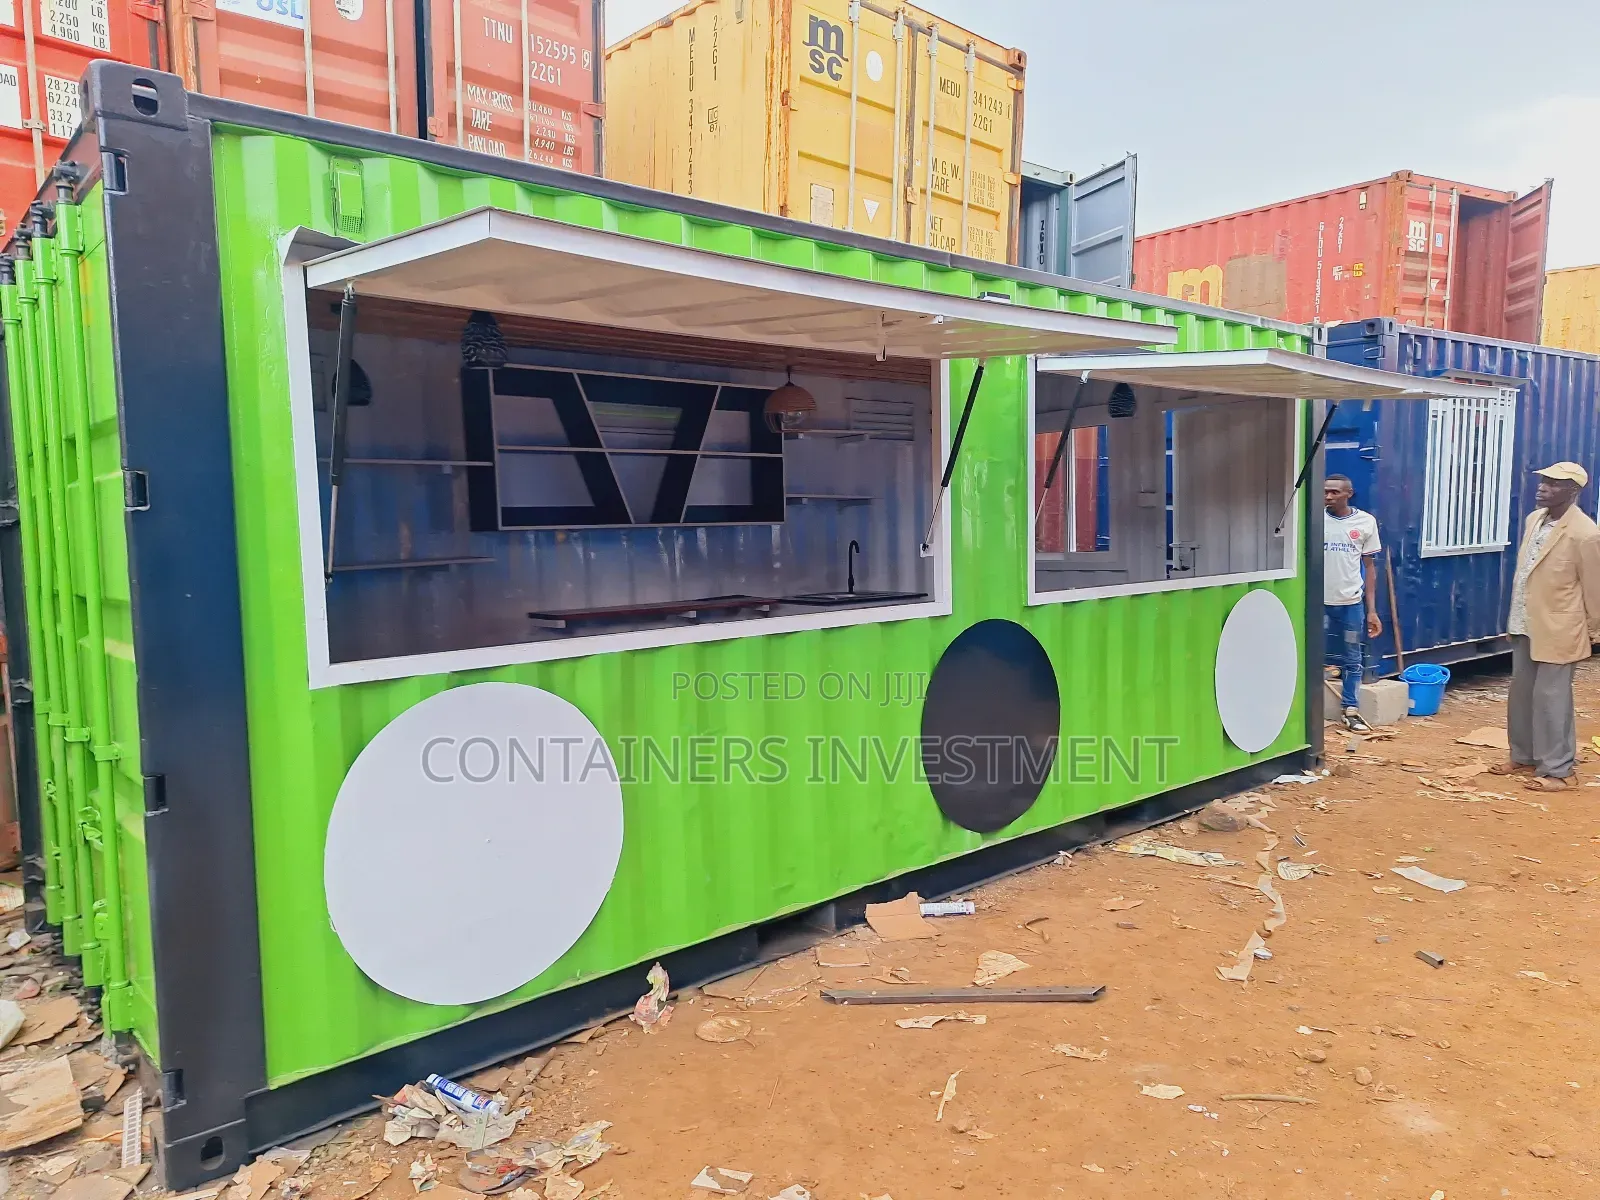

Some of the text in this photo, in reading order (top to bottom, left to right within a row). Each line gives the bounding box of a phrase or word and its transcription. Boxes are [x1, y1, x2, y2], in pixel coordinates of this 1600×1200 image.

[50, 9, 79, 28] 2.250
[50, 24, 80, 42] 4.960
[483, 16, 513, 44] TTNU
[530, 33, 577, 65] 152595
[530, 60, 562, 86] 22G1
[47, 78, 80, 95] 28.23
[939, 76, 961, 99] MEDU
[972, 91, 1003, 115] 341243
[48, 91, 80, 108] 62.24
[50, 109, 72, 124] 33.2
[471, 107, 493, 132] TARE
[972, 112, 993, 133] 22G1
[468, 133, 507, 158] PAYLOAD
